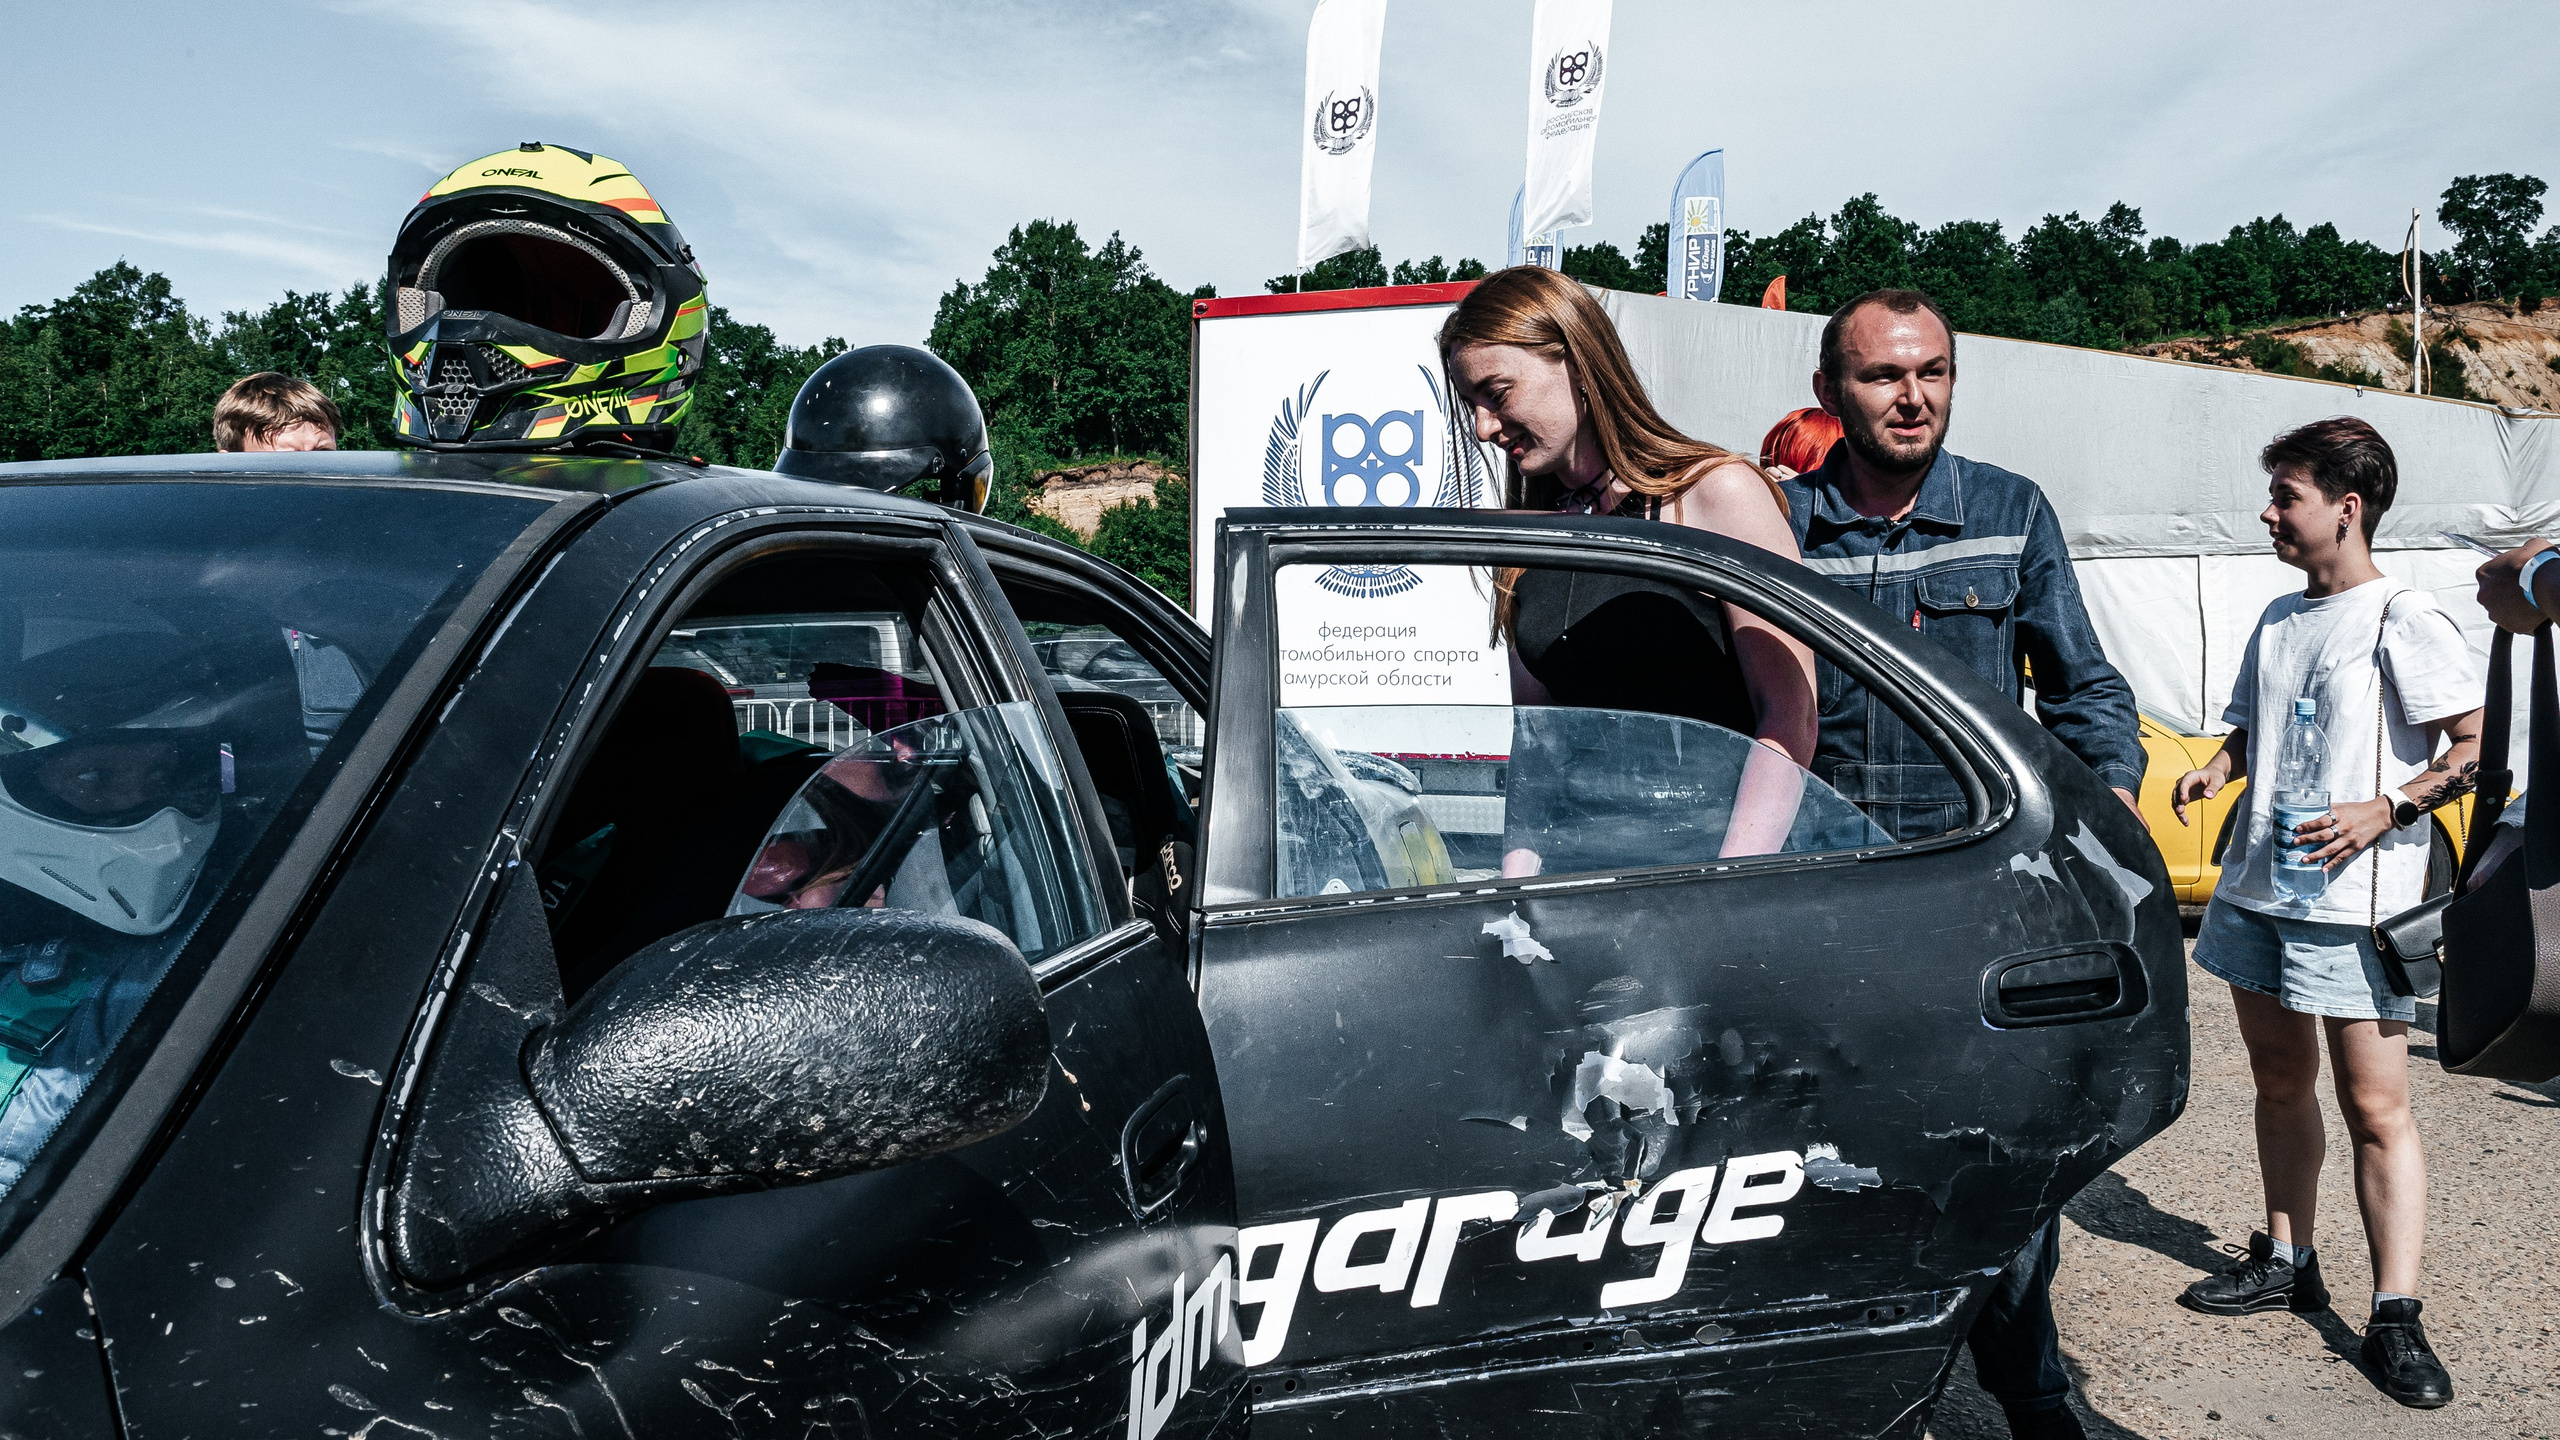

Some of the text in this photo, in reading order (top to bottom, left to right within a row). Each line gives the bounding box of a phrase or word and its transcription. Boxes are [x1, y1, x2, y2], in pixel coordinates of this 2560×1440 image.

[1318, 621, 1417, 642] федерация
[1280, 643, 1479, 666] томобильного спорта
[1284, 668, 1452, 689] амурской области
